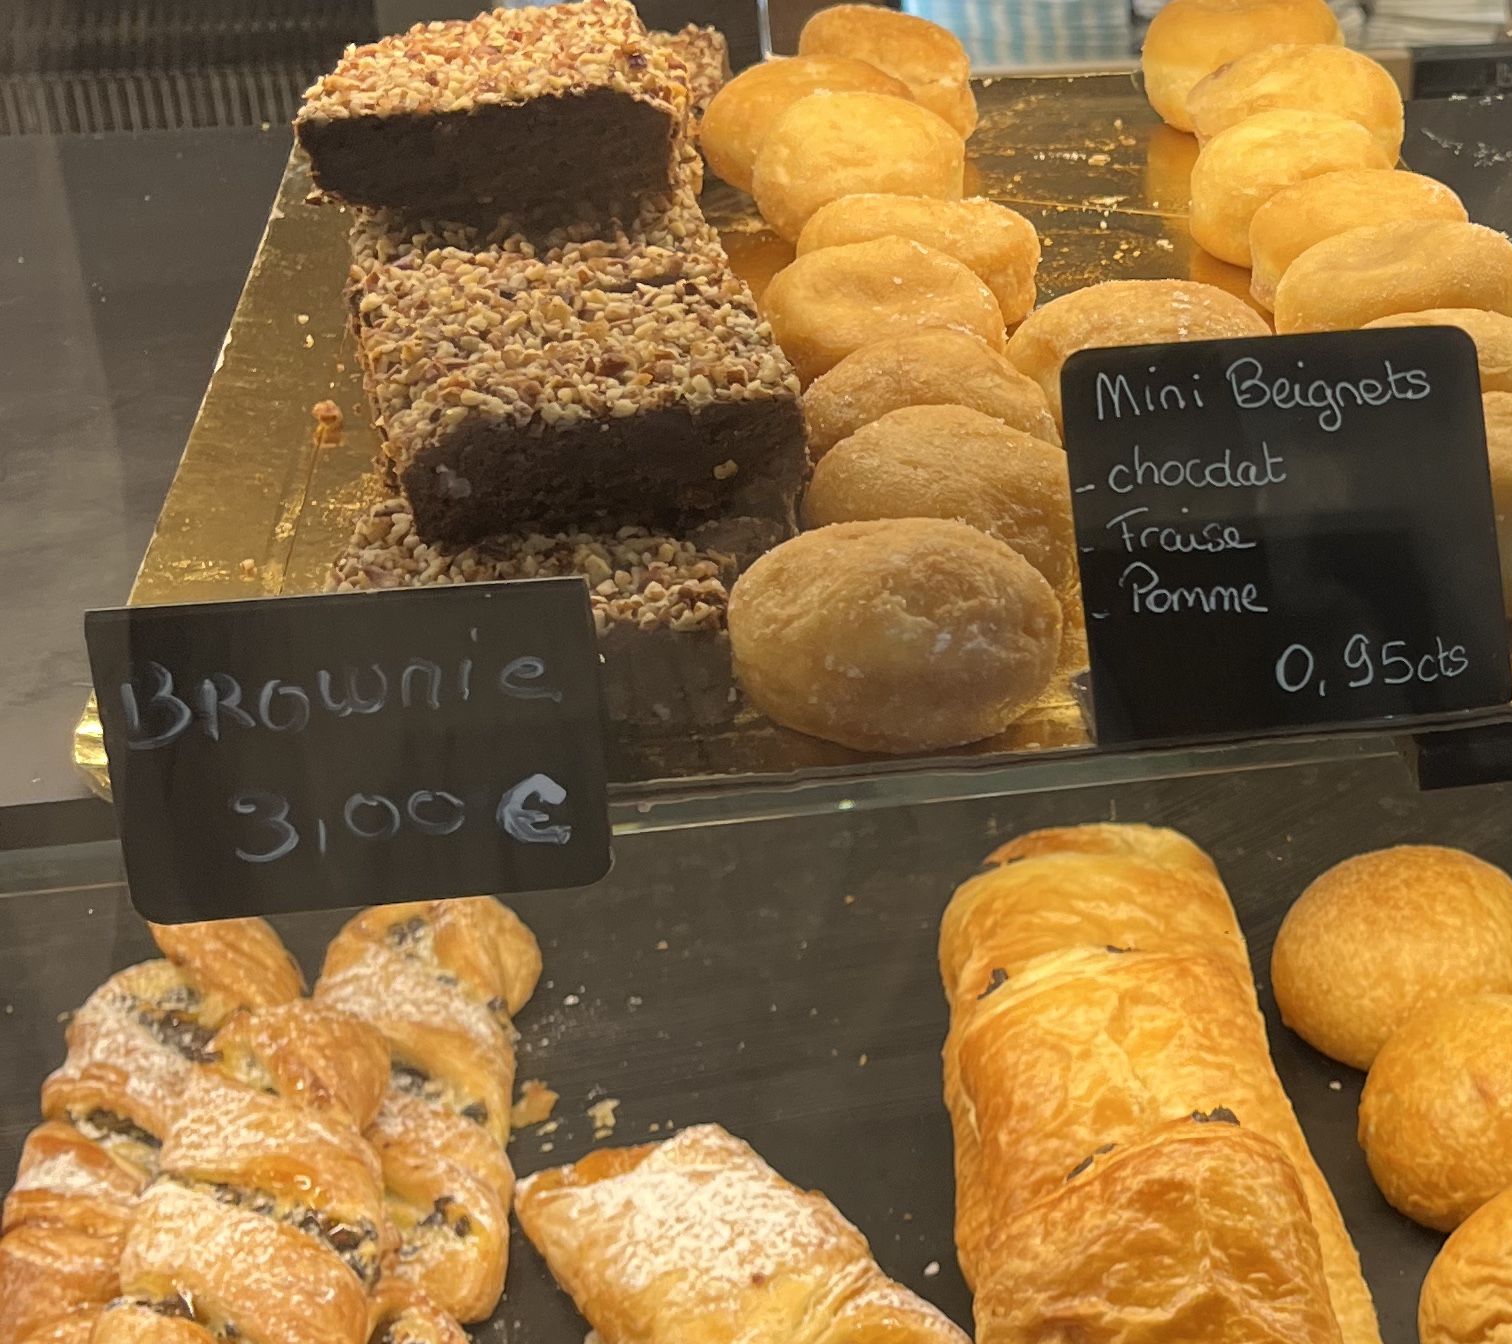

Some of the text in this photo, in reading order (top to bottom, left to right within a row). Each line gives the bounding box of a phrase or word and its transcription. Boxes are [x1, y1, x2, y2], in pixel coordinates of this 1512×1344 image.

[1095, 356, 1432, 433] Mini Beignets
[1106, 506, 1256, 553] Fraise
[1118, 561, 1268, 615] Pomme
